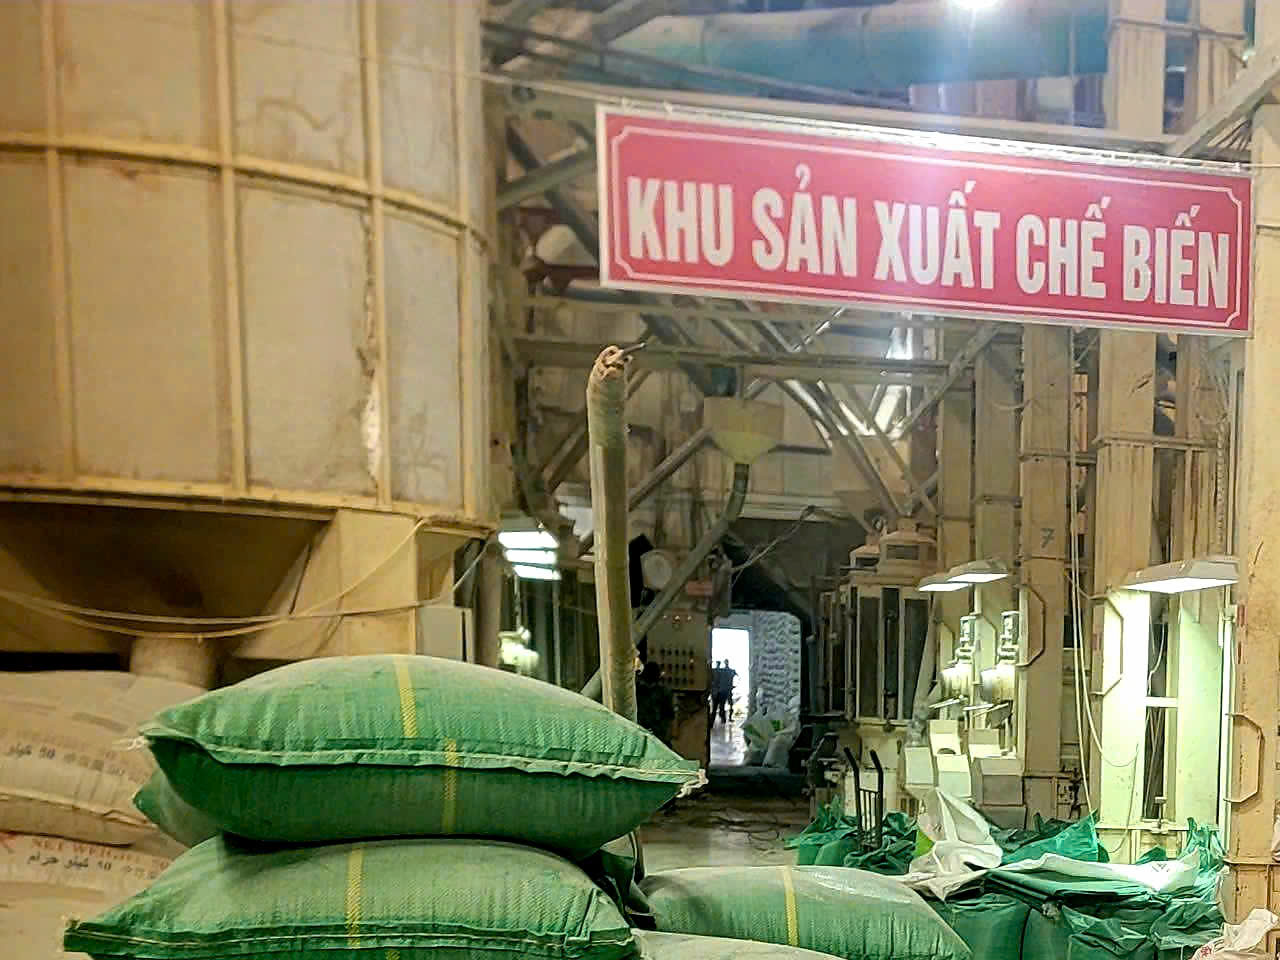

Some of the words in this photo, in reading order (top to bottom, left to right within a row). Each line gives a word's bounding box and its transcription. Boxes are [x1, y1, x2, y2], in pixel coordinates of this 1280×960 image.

[626, 176, 733, 266] KHU
[751, 164, 857, 276] SẢN
[873, 181, 1000, 290] XUẤT
[1014, 197, 1110, 298] CHẾ
[1122, 205, 1229, 309] BIẾN
